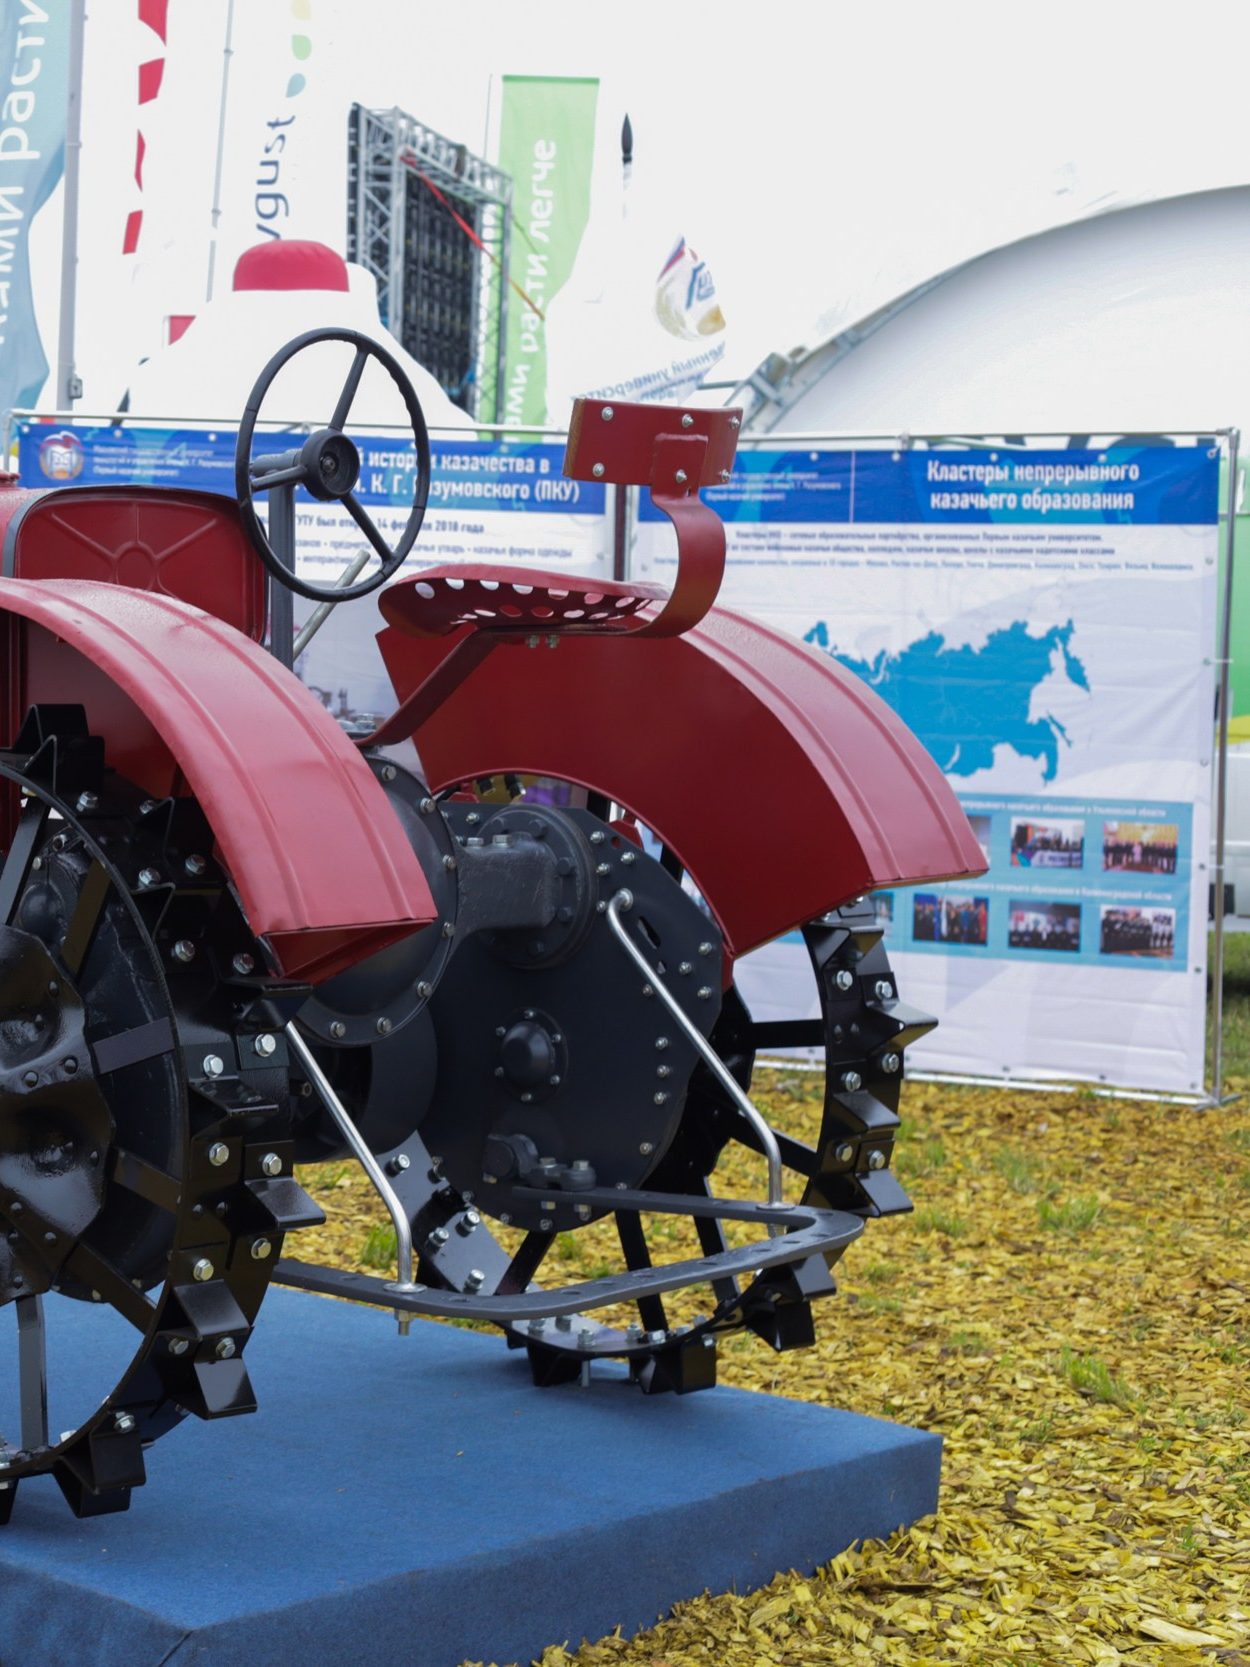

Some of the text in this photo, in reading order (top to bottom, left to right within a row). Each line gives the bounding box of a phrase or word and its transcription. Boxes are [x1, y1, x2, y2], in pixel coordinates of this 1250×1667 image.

[255, 115, 297, 241] vgust
[503, 139, 557, 441] ами расти легче
[368, 451, 437, 474] истори
[441, 453, 536, 474] казачества
[539, 458, 551, 474] в
[927, 460, 1140, 486] Кластеры непрерывного
[370, 473, 388, 495] К.
[393, 475, 409, 496] Г.
[412, 477, 531, 502] зумовского
[534, 479, 580, 504] (ПКУ)
[930, 488, 1135, 514] казачьего образования
[316, 515, 337, 527] был
[377, 518, 388, 529] 14
